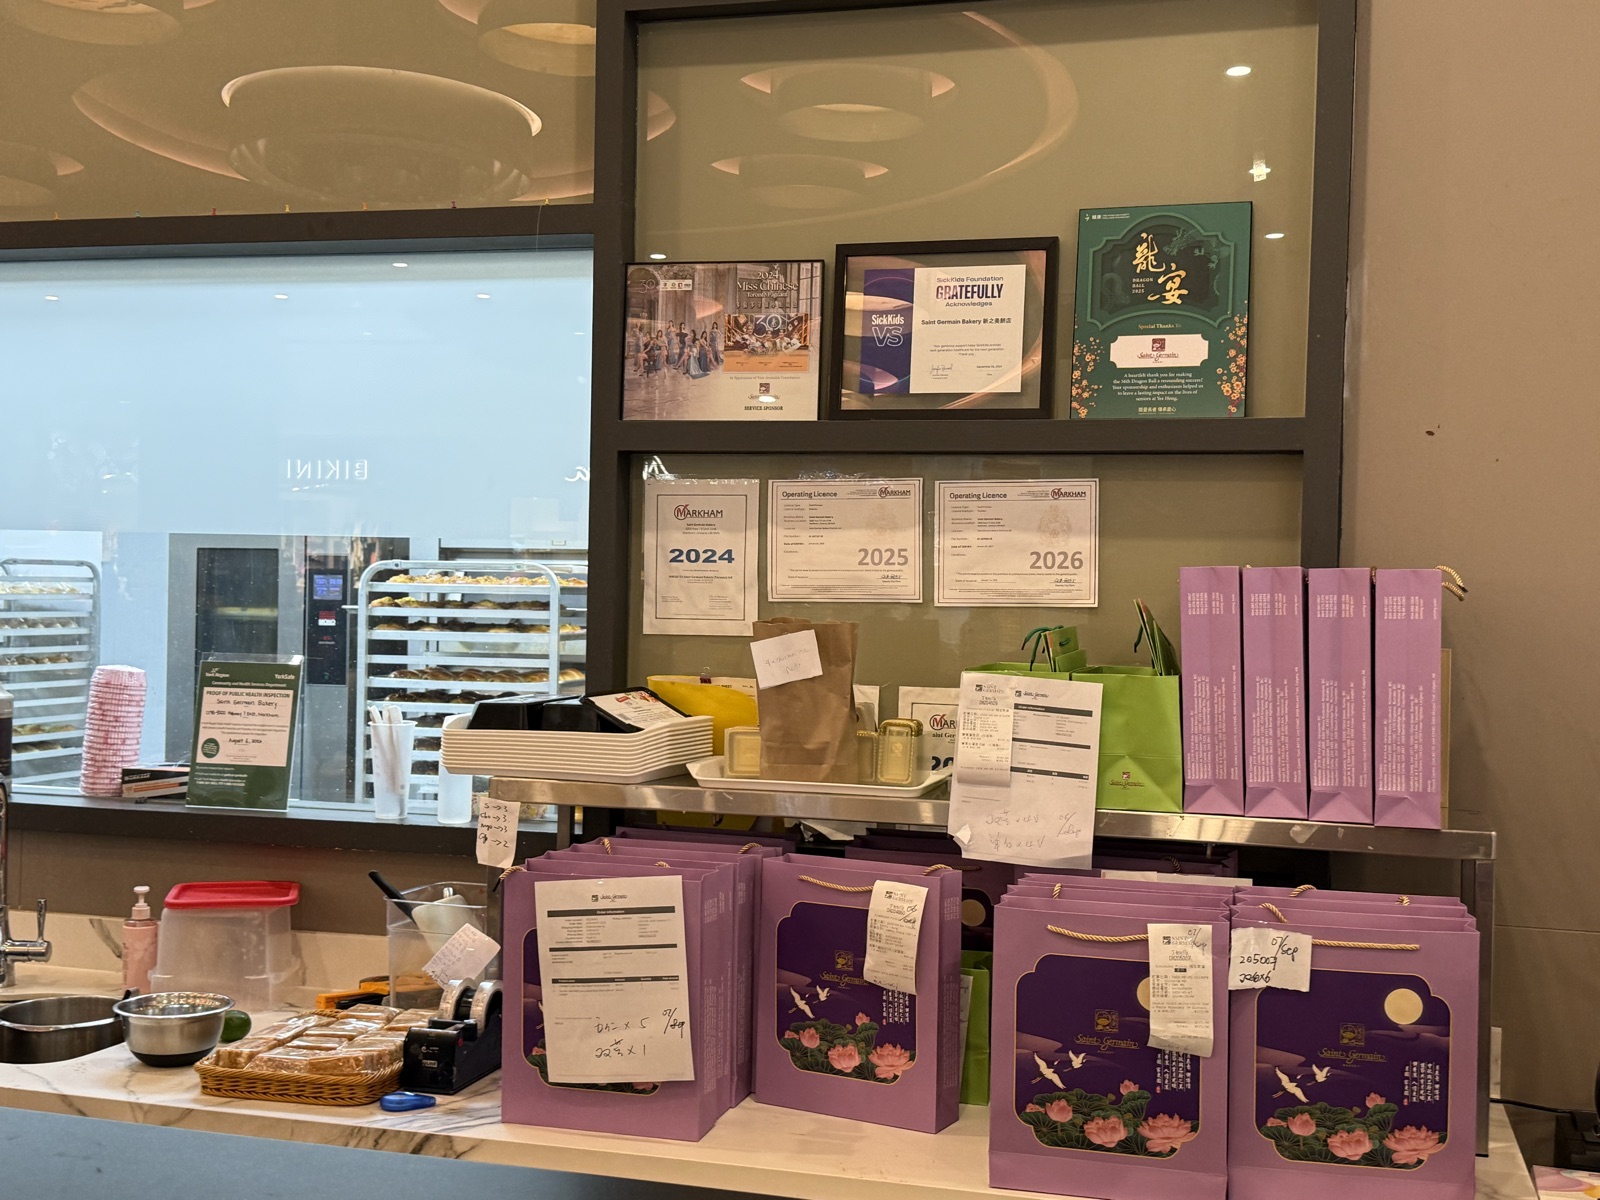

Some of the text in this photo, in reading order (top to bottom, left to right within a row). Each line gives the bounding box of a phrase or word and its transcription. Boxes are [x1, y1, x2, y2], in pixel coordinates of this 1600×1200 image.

[758, 270, 780, 279] 2024
[737, 280, 798, 291] Miss Chinese
[936, 284, 1004, 300] GRATEFULLY
[871, 314, 904, 325] SickKids
[872, 326, 904, 347] VS
[1154, 352, 1179, 361] Germain
[878, 486, 911, 498] MARKHAM
[1051, 488, 1086, 500] MARKHAM
[674, 504, 723, 520] MARKHAM
[669, 549, 735, 563] 2024
[858, 548, 909, 566] 2025
[1029, 551, 1083, 570] 2026
[258, 700, 277, 709] Bakery
[820, 971, 841, 980] Saint
[1074, 1035, 1139, 1049] Saint Germain
[1318, 1048, 1387, 1064] Saint Germain
